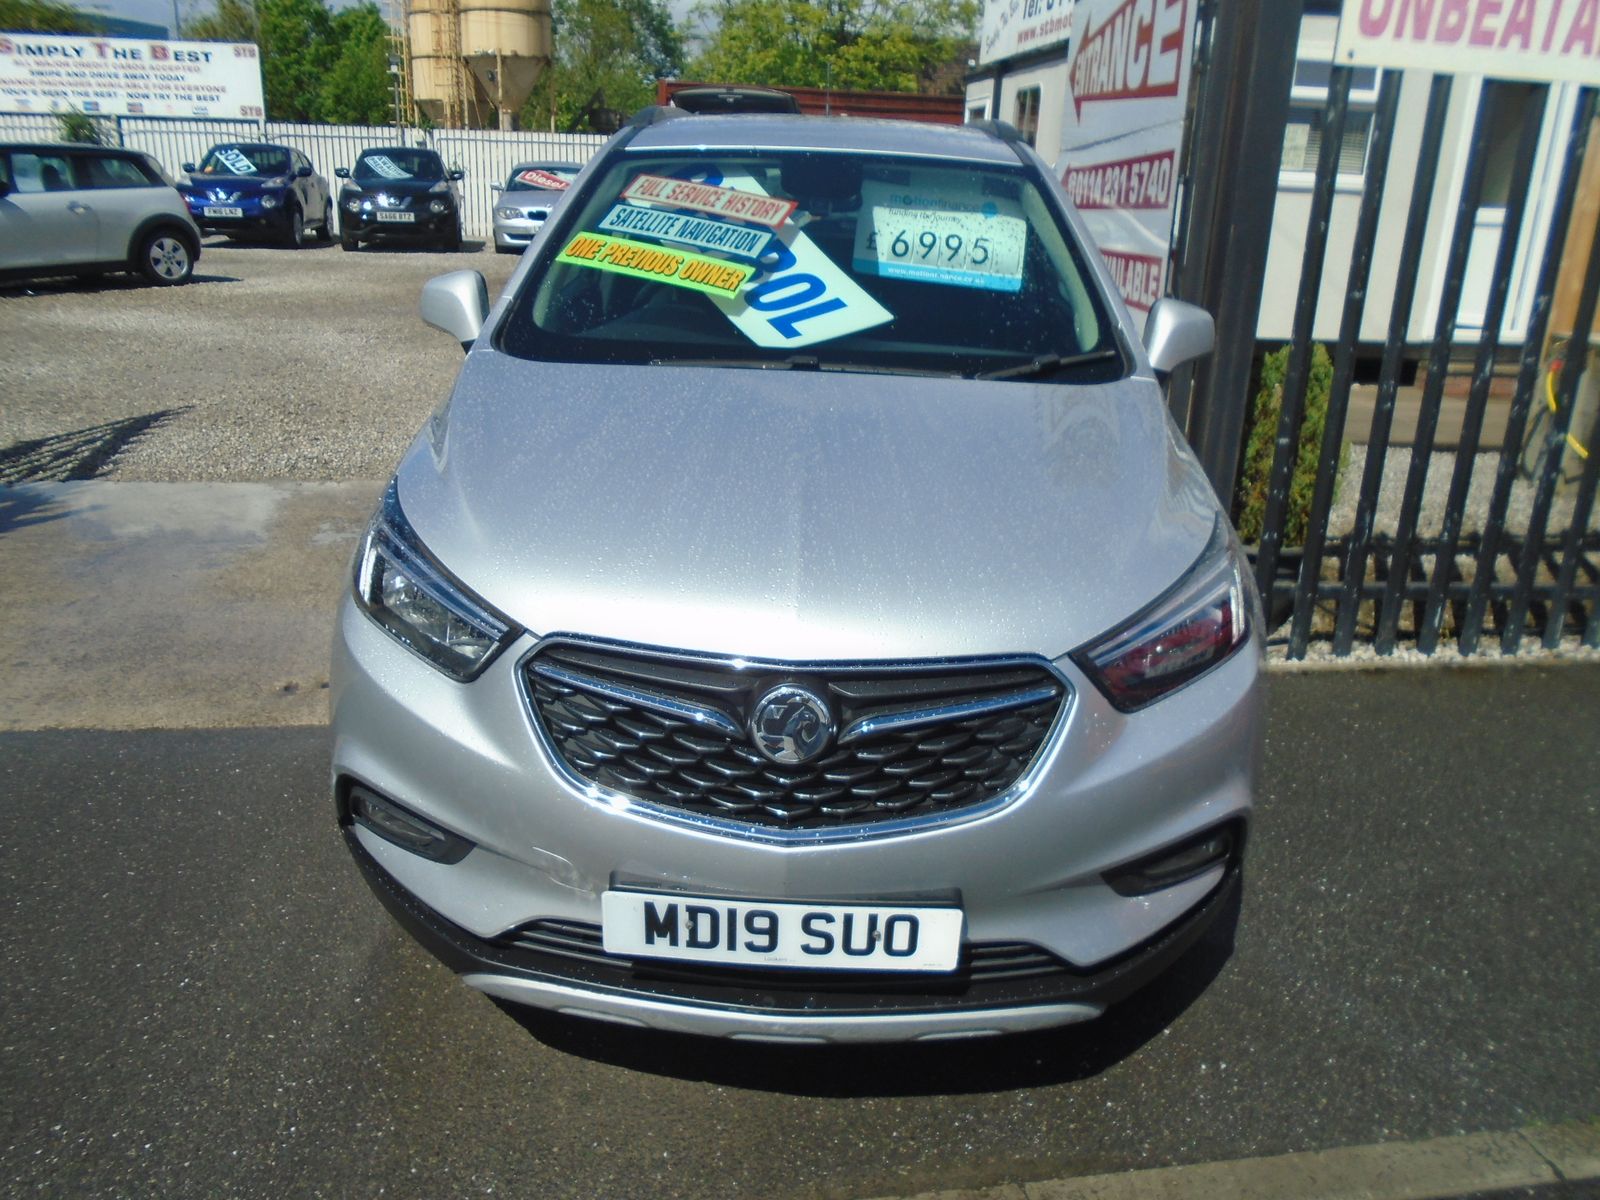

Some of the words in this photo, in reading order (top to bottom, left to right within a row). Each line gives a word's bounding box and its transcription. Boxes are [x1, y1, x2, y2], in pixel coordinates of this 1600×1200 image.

[0, 38, 84, 57] SIMPLY
[92, 41, 142, 60] THE
[151, 44, 213, 63] BEST
[233, 46, 257, 58] STB
[1074, 0, 1183, 97] ENTRANCE
[122, 72, 150, 80] AWAY
[154, 73, 186, 81] TODAY
[174, 84, 227, 93] EVERYONE
[240, 105, 263, 117] STB
[524, 171, 566, 189] Diesel
[1103, 164, 1128, 205] 231
[1129, 157, 1172, 204] 5740
[634, 178, 668, 198] FULL
[666, 181, 725, 207] SERVICE
[721, 192, 784, 221] HISTORY
[609, 208, 680, 235] SATELLITE
[674, 216, 762, 252] NAVIGATION
[565, 236, 607, 259] ONE
[599, 242, 685, 276] PREVIOUS
[679, 258, 746, 291] OWNER
[643, 901, 779, 953] MD19
[800, 911, 920, 957] SUO
